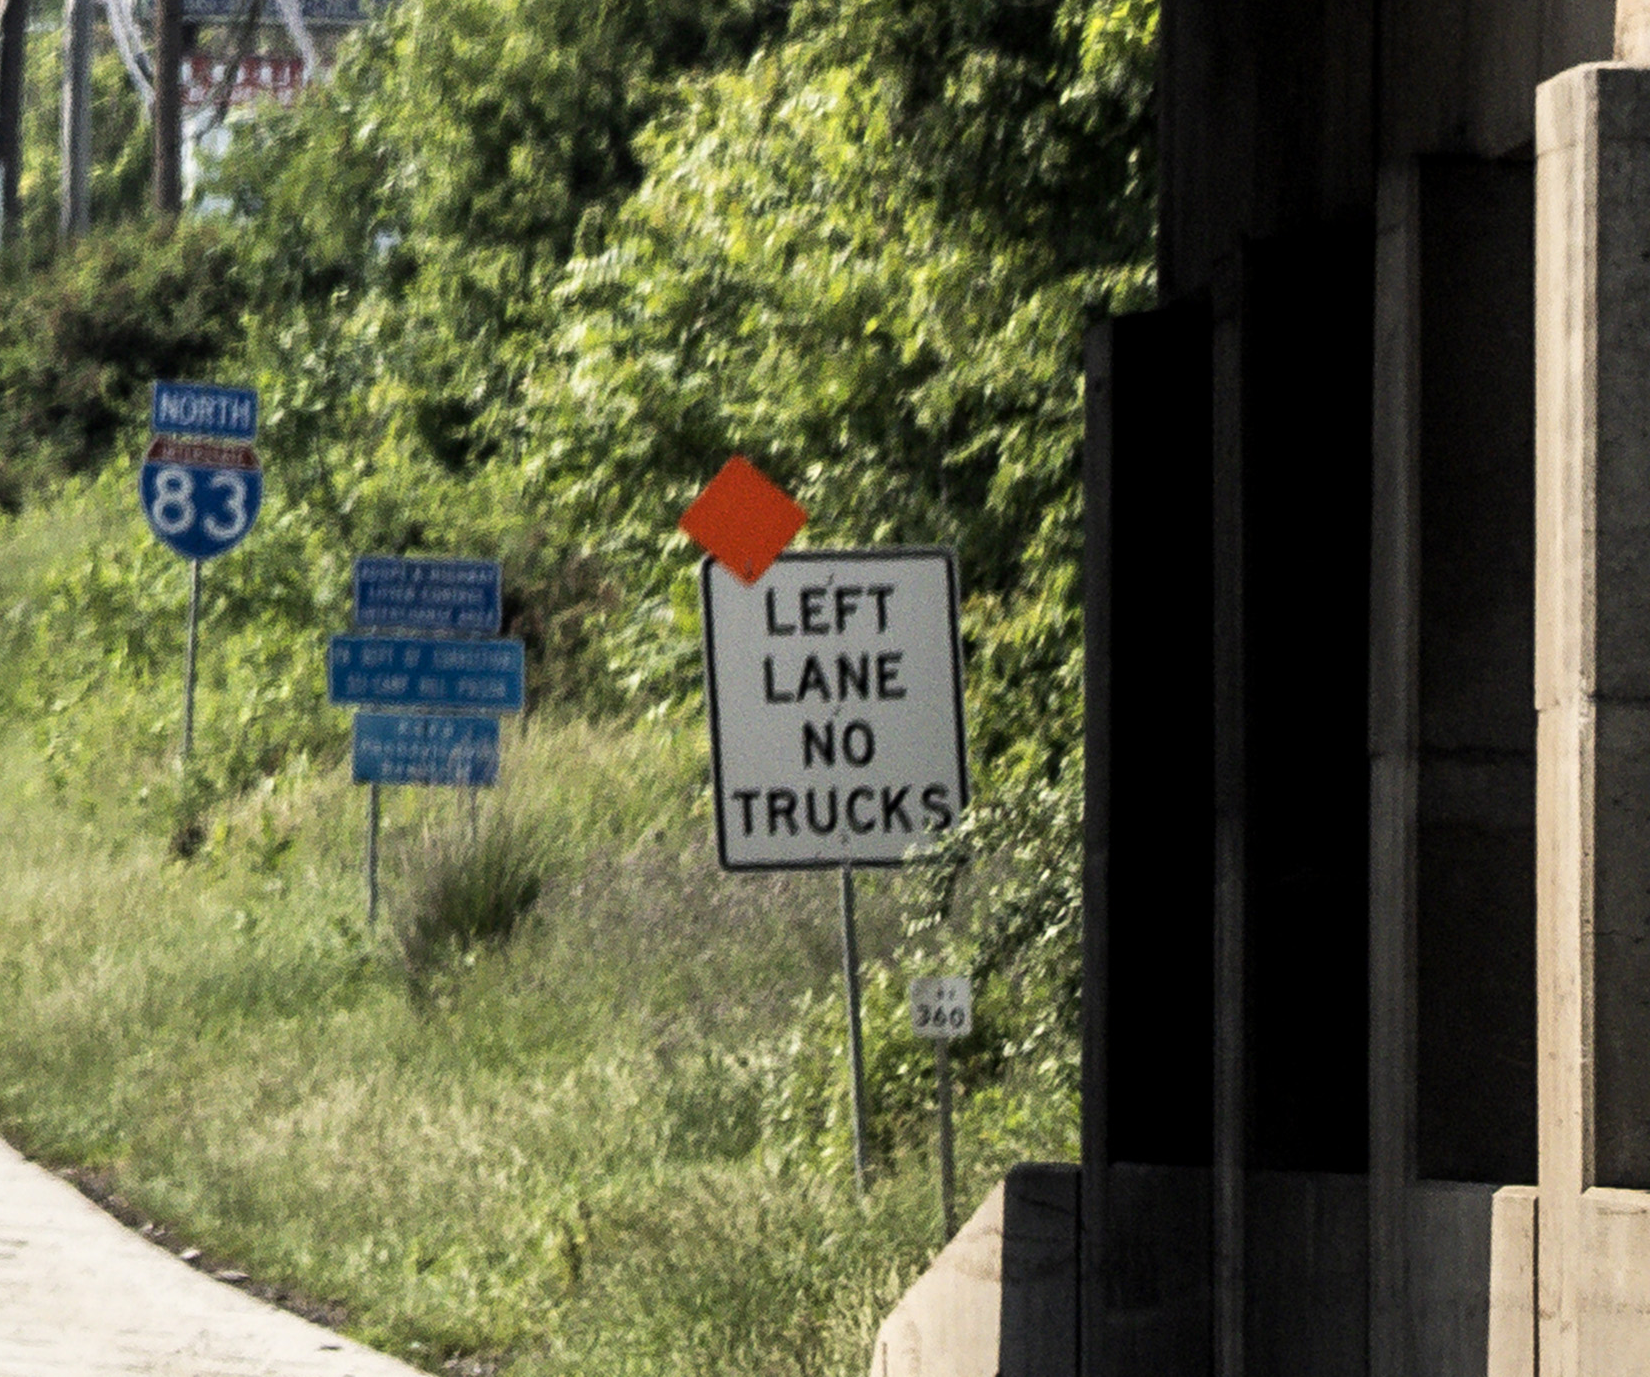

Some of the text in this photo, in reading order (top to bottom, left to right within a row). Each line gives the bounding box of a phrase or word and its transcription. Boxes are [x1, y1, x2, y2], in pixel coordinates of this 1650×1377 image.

[160, 392, 251, 430] NORTH
[152, 466, 248, 541] 83
[766, 585, 896, 637] LEFT
[763, 651, 907, 705] LANE
[802, 719, 876, 770] NO
[731, 784, 954, 838] TRUCKS
[915, 1003, 966, 1029] 360
